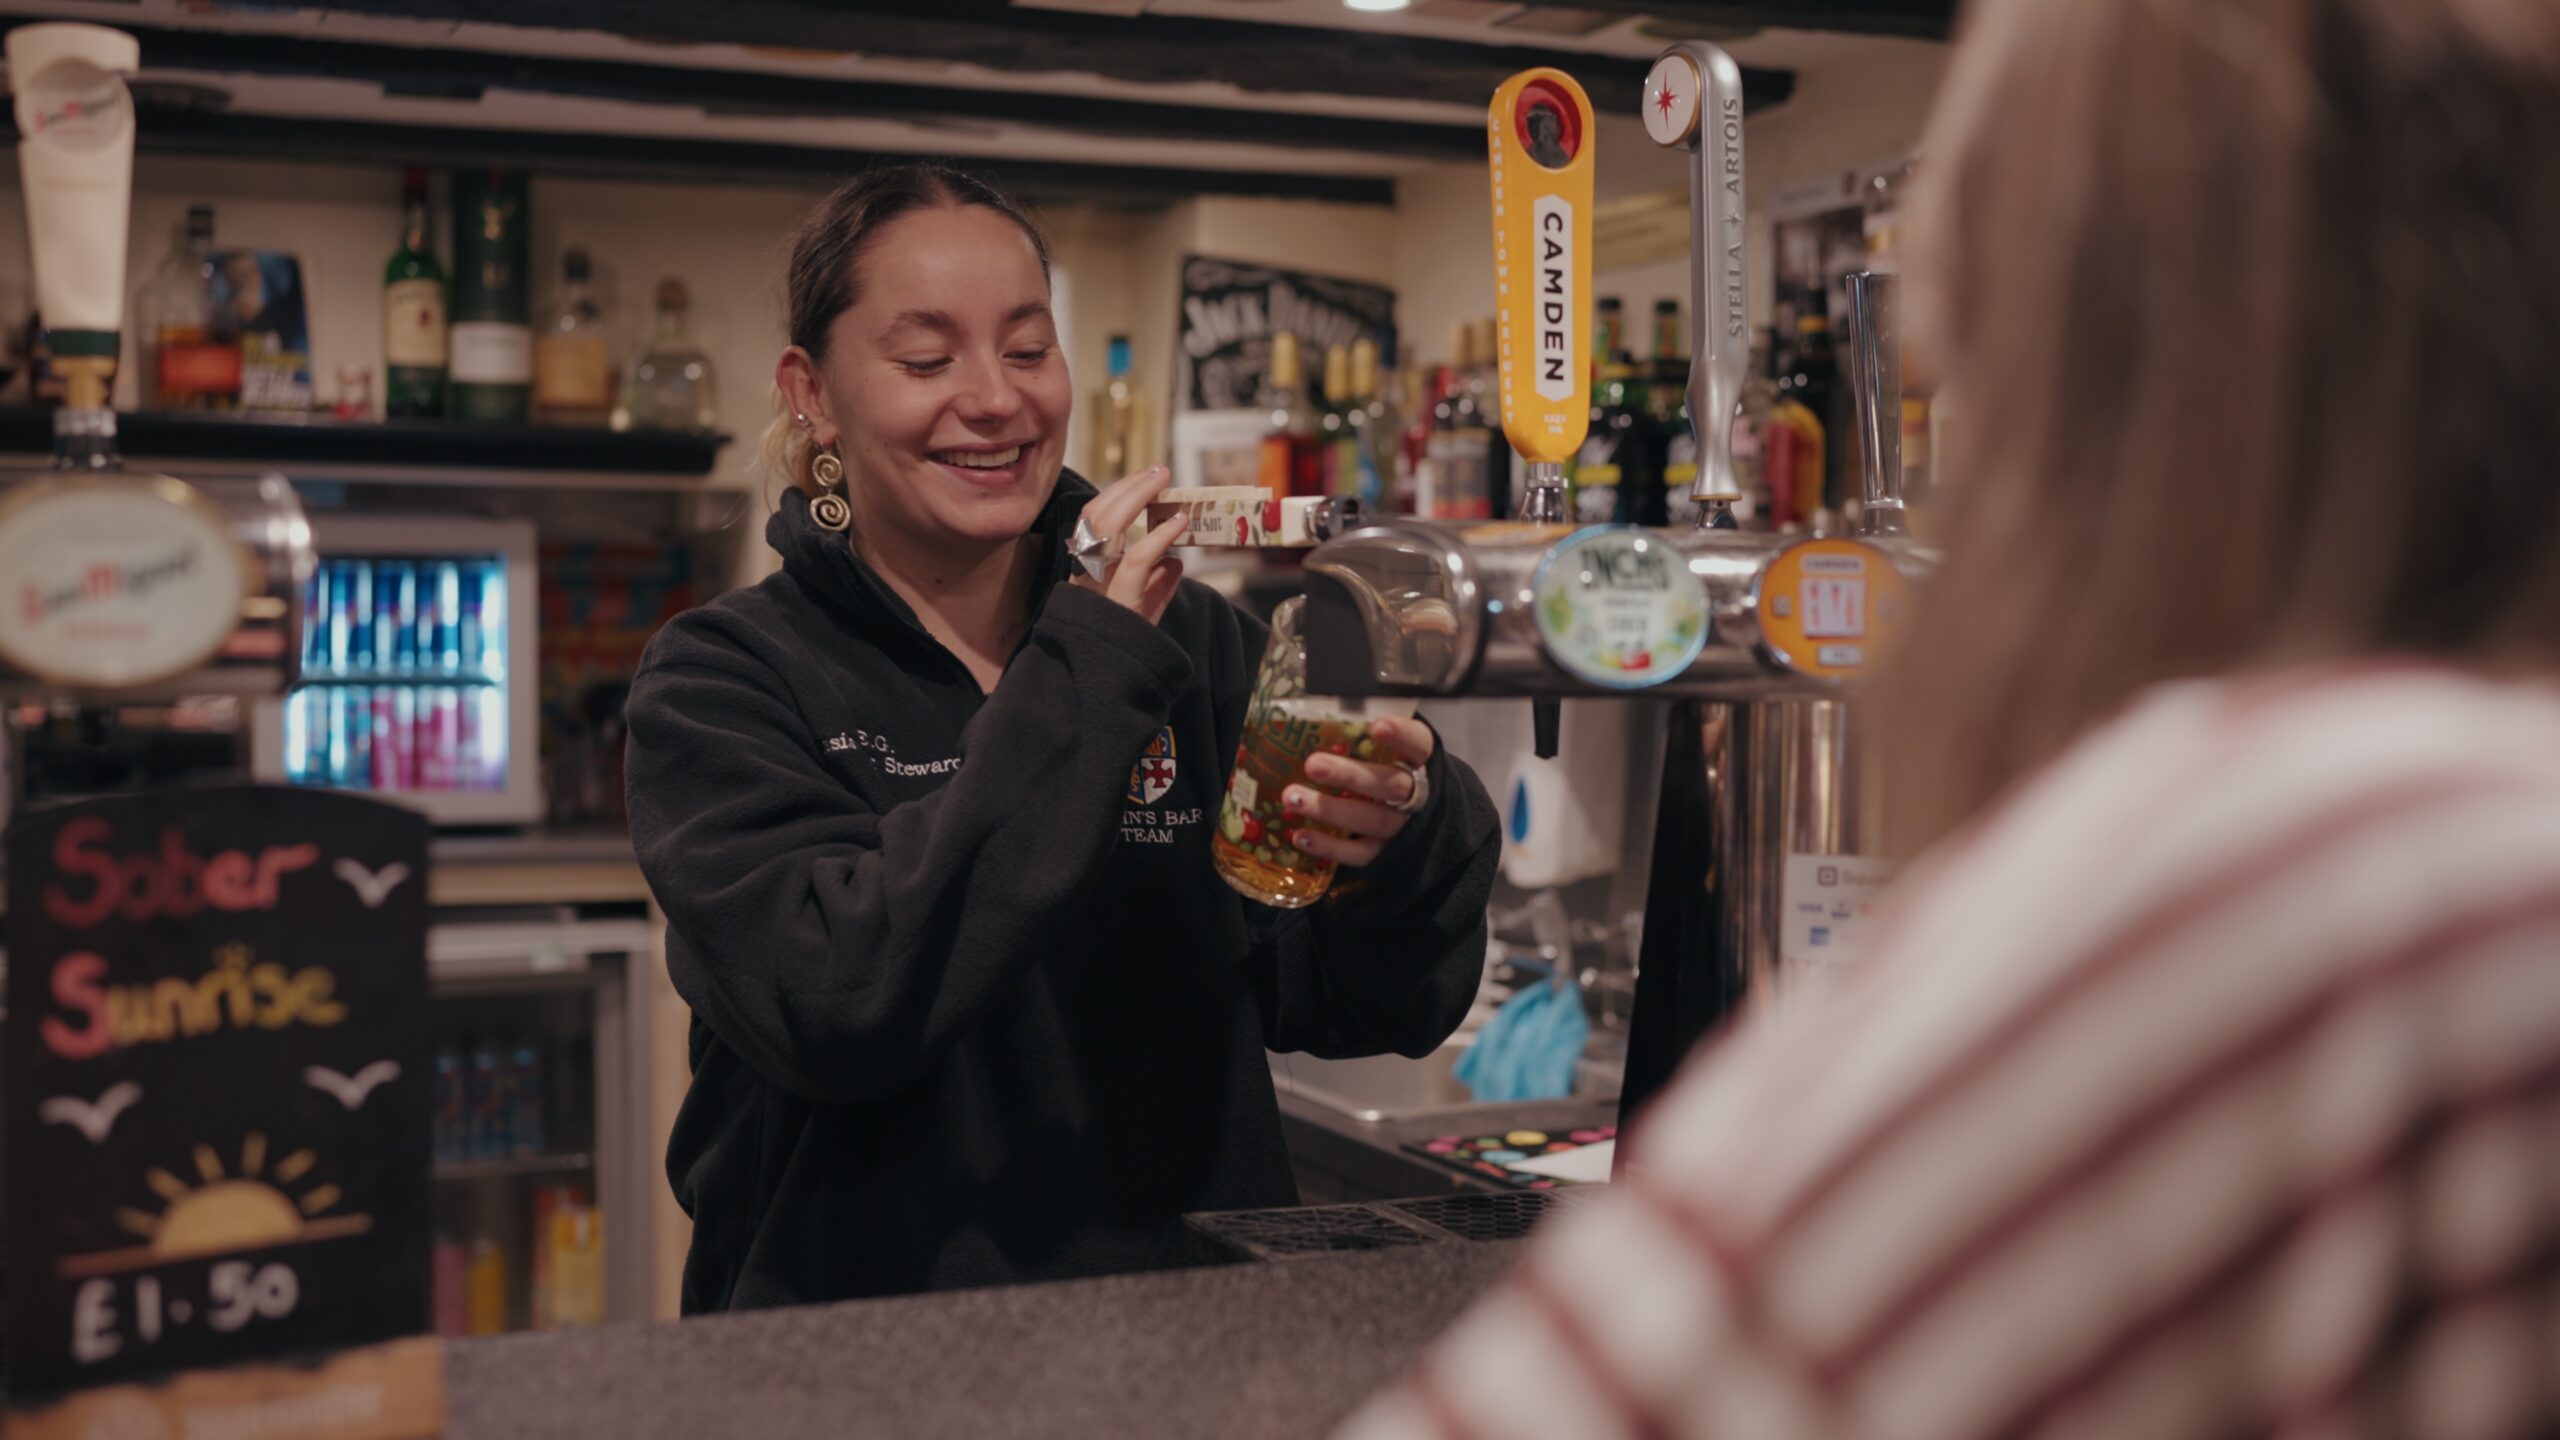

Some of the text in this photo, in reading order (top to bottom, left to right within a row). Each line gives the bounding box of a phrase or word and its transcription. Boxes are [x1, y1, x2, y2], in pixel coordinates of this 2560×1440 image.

[1723, 97, 1744, 339] STELLA ARTOIS
[1543, 210, 1565, 382] CAMDEN
[43, 815, 320, 928] Sober
[1121, 827, 1174, 843] TEAM
[1165, 808, 1202, 825] BAR
[40, 942, 349, 1060] Sunrise
